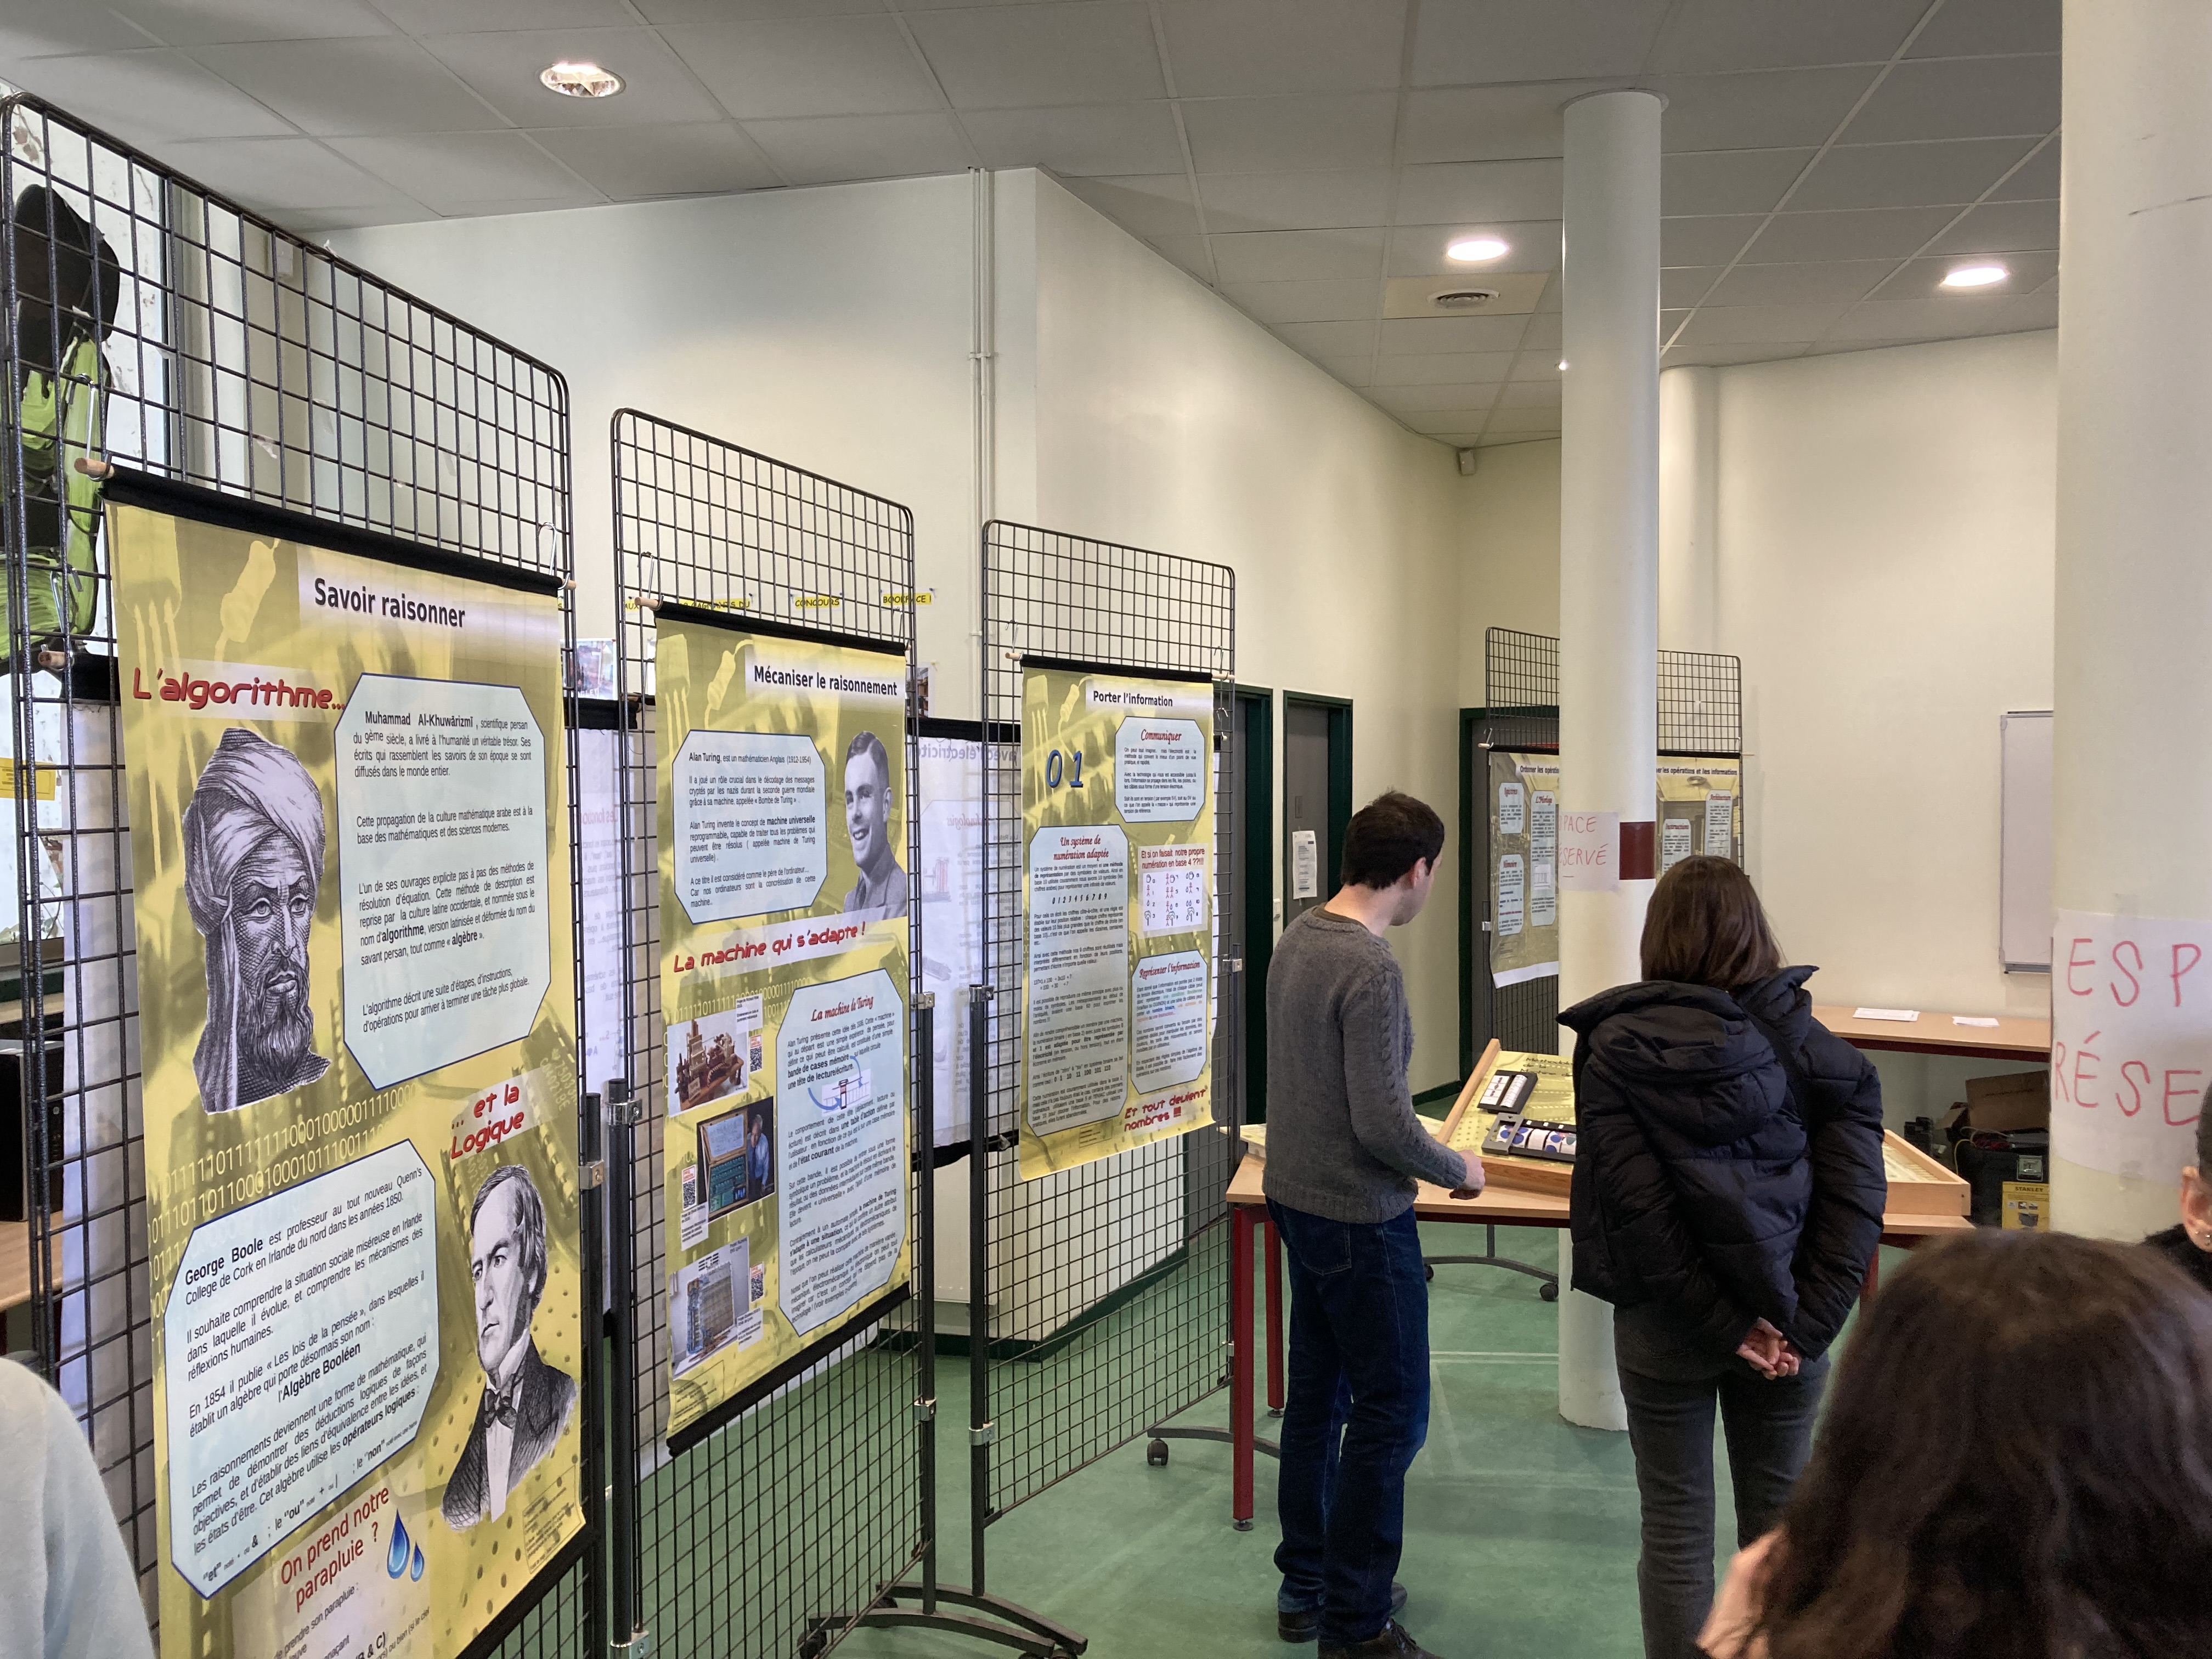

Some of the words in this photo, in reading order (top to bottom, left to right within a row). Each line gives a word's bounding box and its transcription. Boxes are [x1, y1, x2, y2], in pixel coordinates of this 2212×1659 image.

[314, 578, 376, 613] Savoir
[382, 595, 465, 628] raisonner
[754, 665, 813, 689] Mécaniser
[817, 672, 826, 689] le
[830, 675, 897, 696] raisonnement
[1093, 691, 1121, 703] Porter
[1124, 692, 1173, 707] l'information
[365, 710, 410, 725] Muhammad
[481, 718, 507, 730] scientifique
[510, 721, 527, 730] persan
[353, 732, 362, 743] du
[364, 730, 383, 744] 9ème
[386, 732, 406, 746] siècle,
[409, 736, 413, 744] a
[415, 733, 429, 745] livré
[432, 734, 436, 745] à
[472, 737, 478, 746] un
[480, 735, 501, 746] véritable
[503, 736, 518, 746] trésor.
[521, 737, 531, 746] Ses
[1141, 729, 1181, 744] Communiquer
[354, 749, 372, 760] écrits
[376, 752, 385, 763] qui
[389, 749, 428, 760] rassemblent
[431, 749, 441, 760] les
[444, 752, 466, 760] savoirs
[469, 750, 475, 760] de
[478, 752, 487, 760] son
[489, 750, 508, 761] époque
[520, 752, 531, 760] sont
[689, 752, 701, 761] Alan
[702, 752, 721, 764] Turing,
[769, 755, 785, 764] Anglais
[354, 766, 380, 777] diffusés
[382, 765, 397, 776] dans
[399, 765, 404, 776] le
[407, 765, 428, 776] monde
[431, 765, 450, 776] entier.
[1671, 766, 1695, 775] opérations
[1060, 837, 1070, 846] Un
[1070, 836, 1092, 849] système
[1094, 834, 1101, 844] de
[1053, 850, 1085, 860] numération
[1087, 848, 1109, 861] adaptée
[1159, 848, 1172, 857] faisait
[1189, 848, 1205, 857] propre
[1142, 859, 1167, 868] numération
[361, 951, 382, 965] savant
[383, 947, 408, 963] persan,
[410, 943, 422, 954] tout
[424, 939, 444, 951] comme
[452, 932, 477, 947] algèbre
[674, 955, 695, 973] La
[701, 941, 766, 967] machine
[772, 934, 792, 956] qui
[798, 926, 857, 947] s'adapte
[861, 921, 866, 936] !
[1139, 967, 1167, 980] Représenter
[811, 1008, 823, 1022] La
[825, 1001, 849, 1019] machine
[851, 997, 856, 1012] de
[857, 995, 873, 1011] Turing
[473, 1091, 498, 1119] et
[505, 1083, 520, 1106] la
[1125, 1108, 1137, 1119] Et
[1169, 1088, 1206, 1105] devient
[1125, 1112, 1169, 1132] nombres
[450, 1110, 524, 1160] Logique
[185, 1257, 224, 1285] George
[232, 1238, 263, 1262] Boole
[269, 1231, 281, 1245] est
[287, 1211, 328, 1240] professeur
[332, 1205, 341, 1216] au
[347, 1195, 359, 1209] tout
[365, 1182, 392, 1201] nouveau
[185, 1281, 217, 1305] College
[219, 1273, 230, 1287] de
[233, 1261, 253, 1280] Cork
[256, 1257, 266, 1269] en
[268, 1243, 295, 1263] Irlande
[297, 1237, 307, 1249] du
[309, 1226, 326, 1244] nord
[328, 1220, 346, 1235] dans
[348, 1214, 358, 1226] les
[359, 1201, 384, 1220] années
[386, 1191, 403, 1207] 1850.
[323, 1344, 360, 1374] Booléen
[281, 1555, 302, 1585] On
[307, 1516, 349, 1570] prend
[353, 1486, 389, 1527] notre
[295, 1538, 364, 1612] parapluie
[372, 1522, 378, 1543] ?
